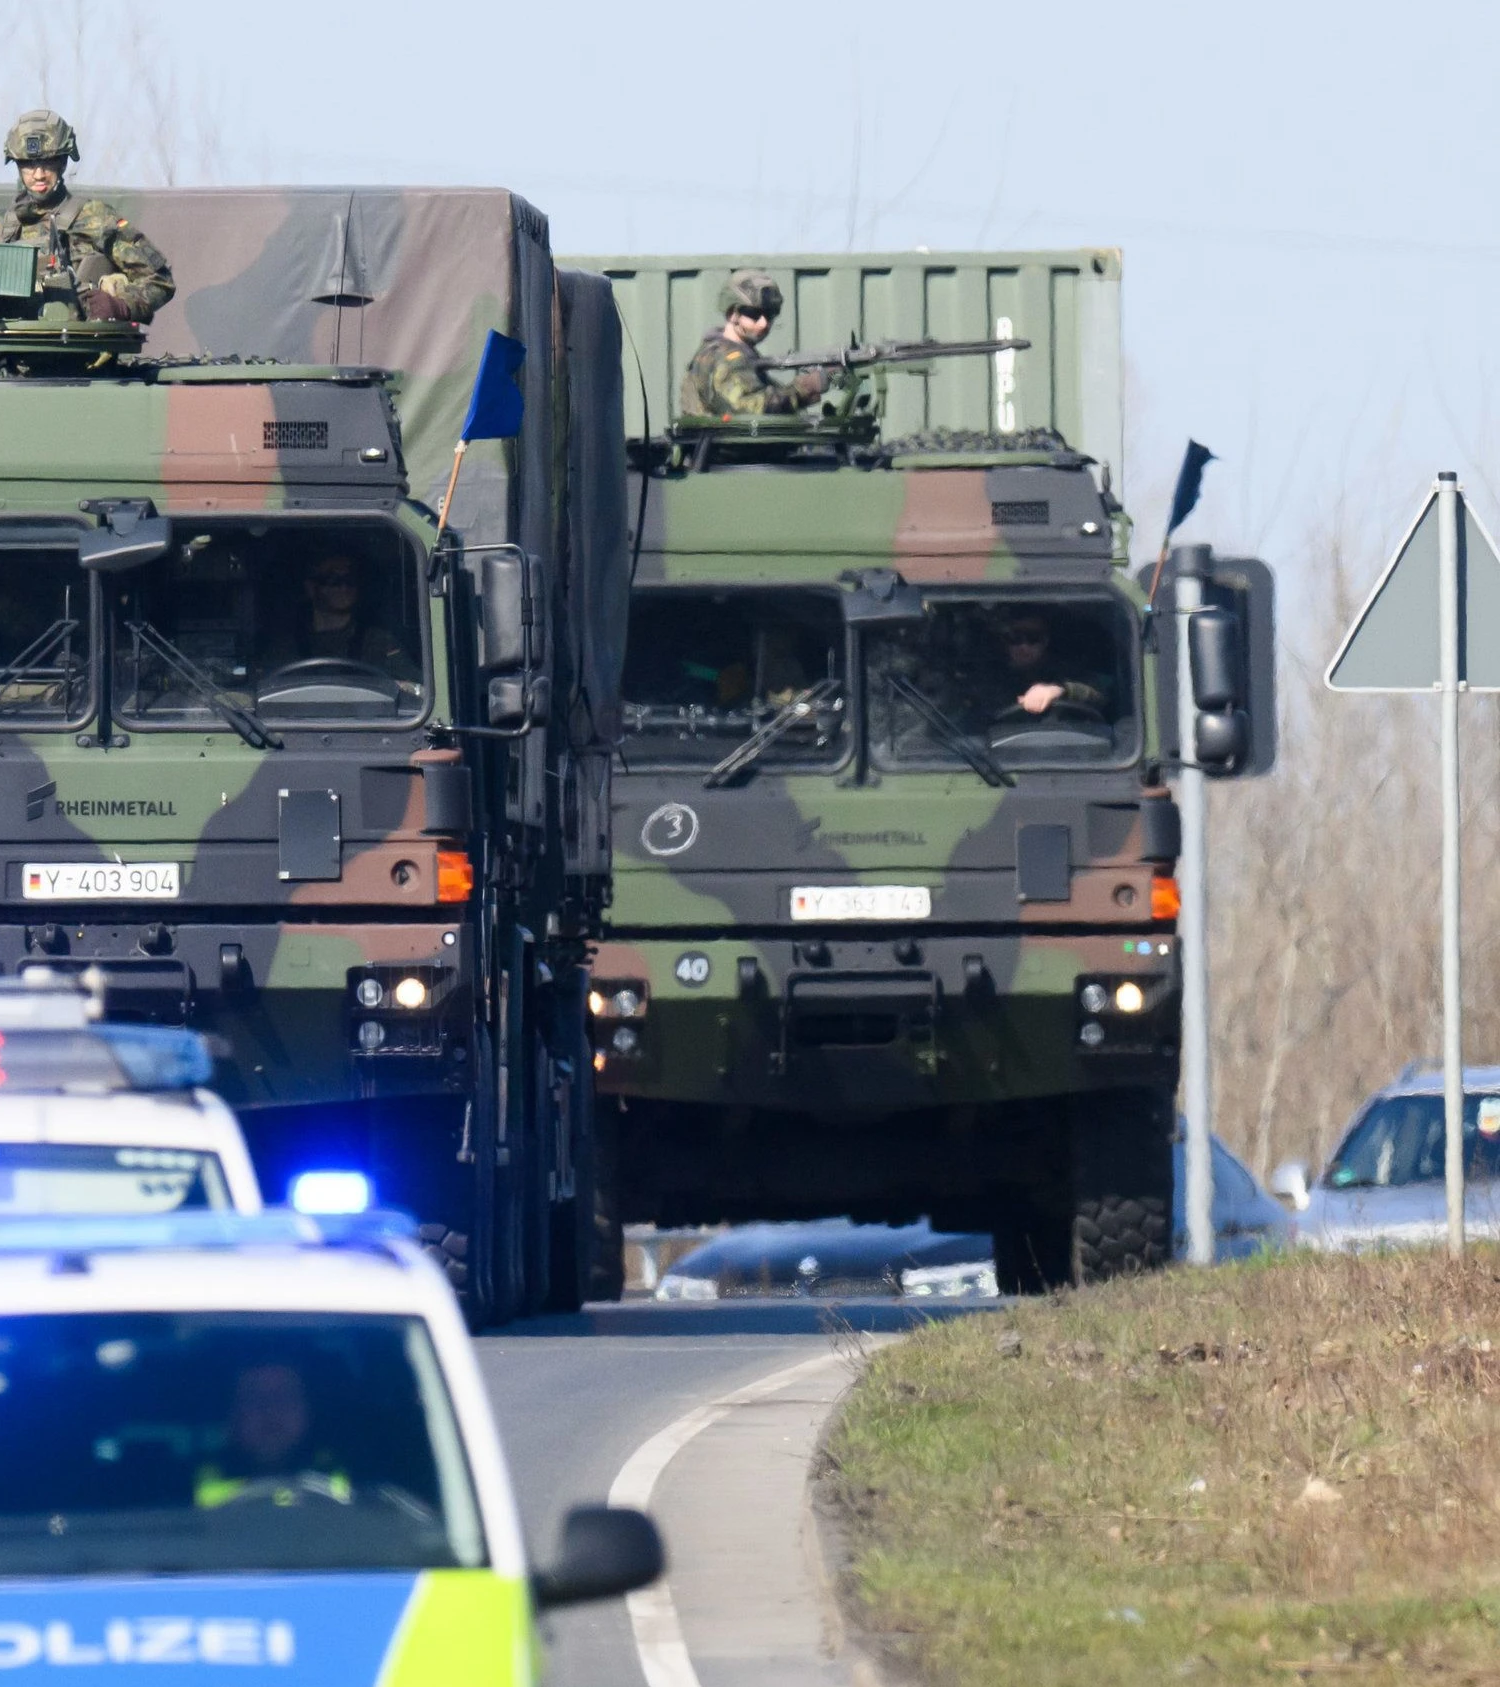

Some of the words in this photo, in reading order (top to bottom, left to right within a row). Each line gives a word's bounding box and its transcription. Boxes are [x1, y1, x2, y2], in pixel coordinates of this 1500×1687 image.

[56, 800, 177, 816] RHEINMETALL
[663, 810, 683, 839] 3
[130, 869, 174, 892] 904
[675, 957, 710, 982] 40
